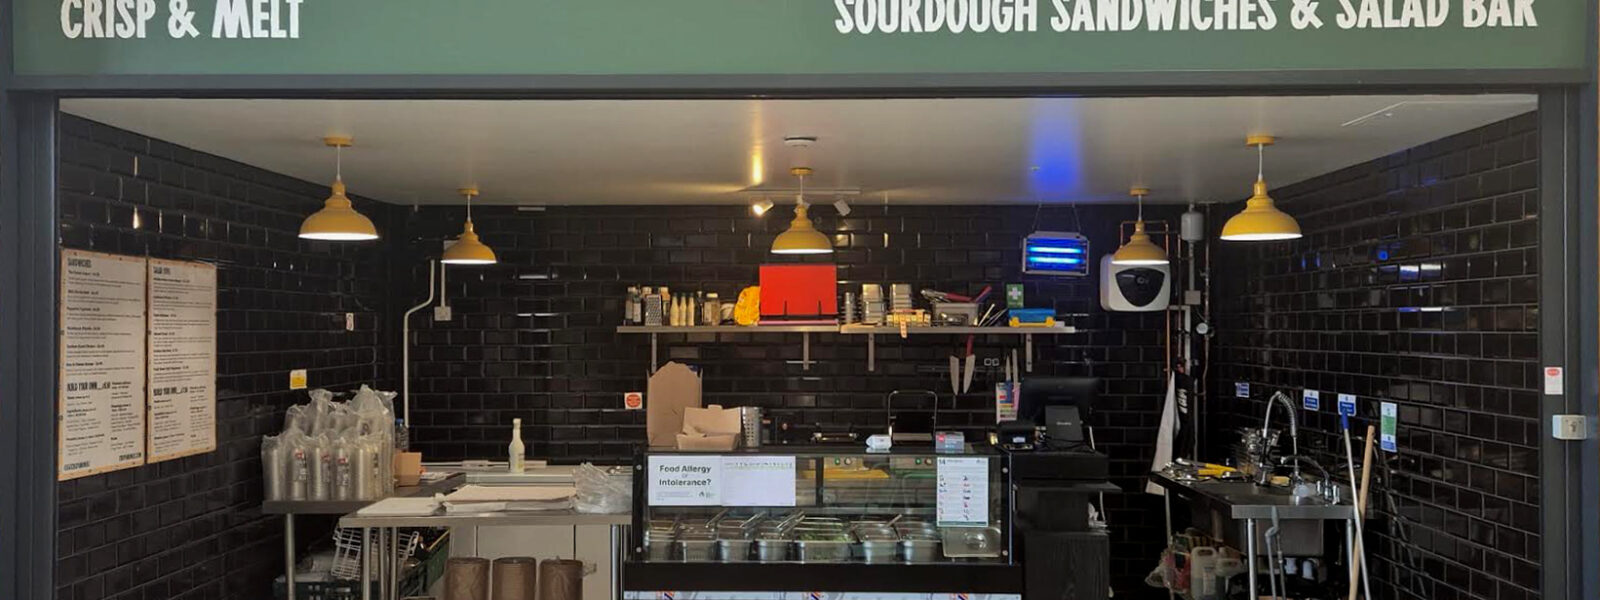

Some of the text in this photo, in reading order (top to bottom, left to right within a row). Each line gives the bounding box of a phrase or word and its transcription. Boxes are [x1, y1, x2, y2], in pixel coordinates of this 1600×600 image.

[60, 0, 304, 39] CRISP & MELT
[834, 0, 1538, 34] SOURDOUGH SANDWICHES & SALAD BAR
[659, 465, 711, 474] Food Allergy
